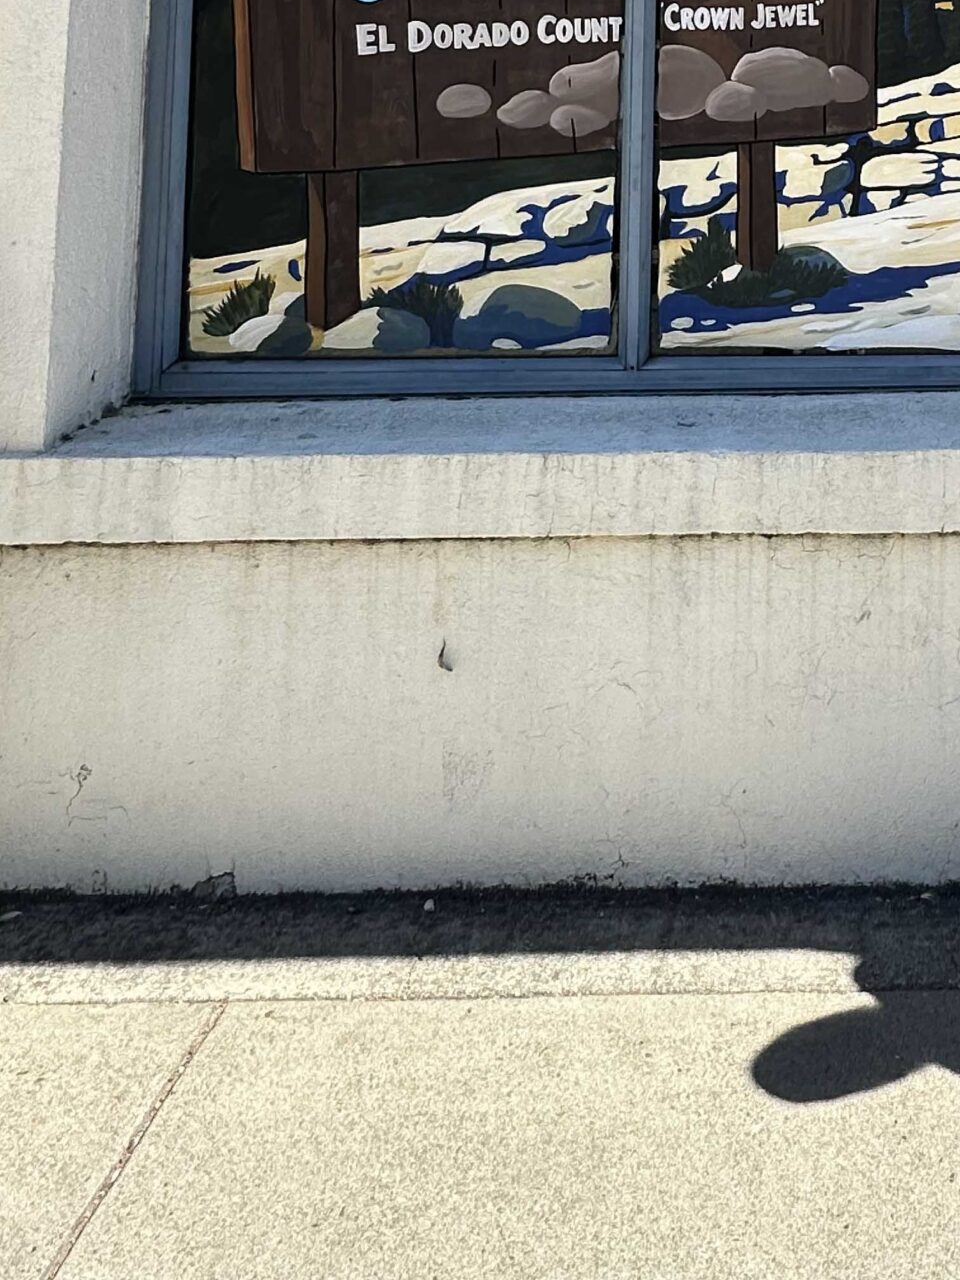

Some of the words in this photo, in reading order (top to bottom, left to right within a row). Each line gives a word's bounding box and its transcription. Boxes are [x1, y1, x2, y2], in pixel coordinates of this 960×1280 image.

[356, 23, 396, 56] EL
[407, 20, 530, 53] DORADO
[536, 14, 623, 43] COUNT
